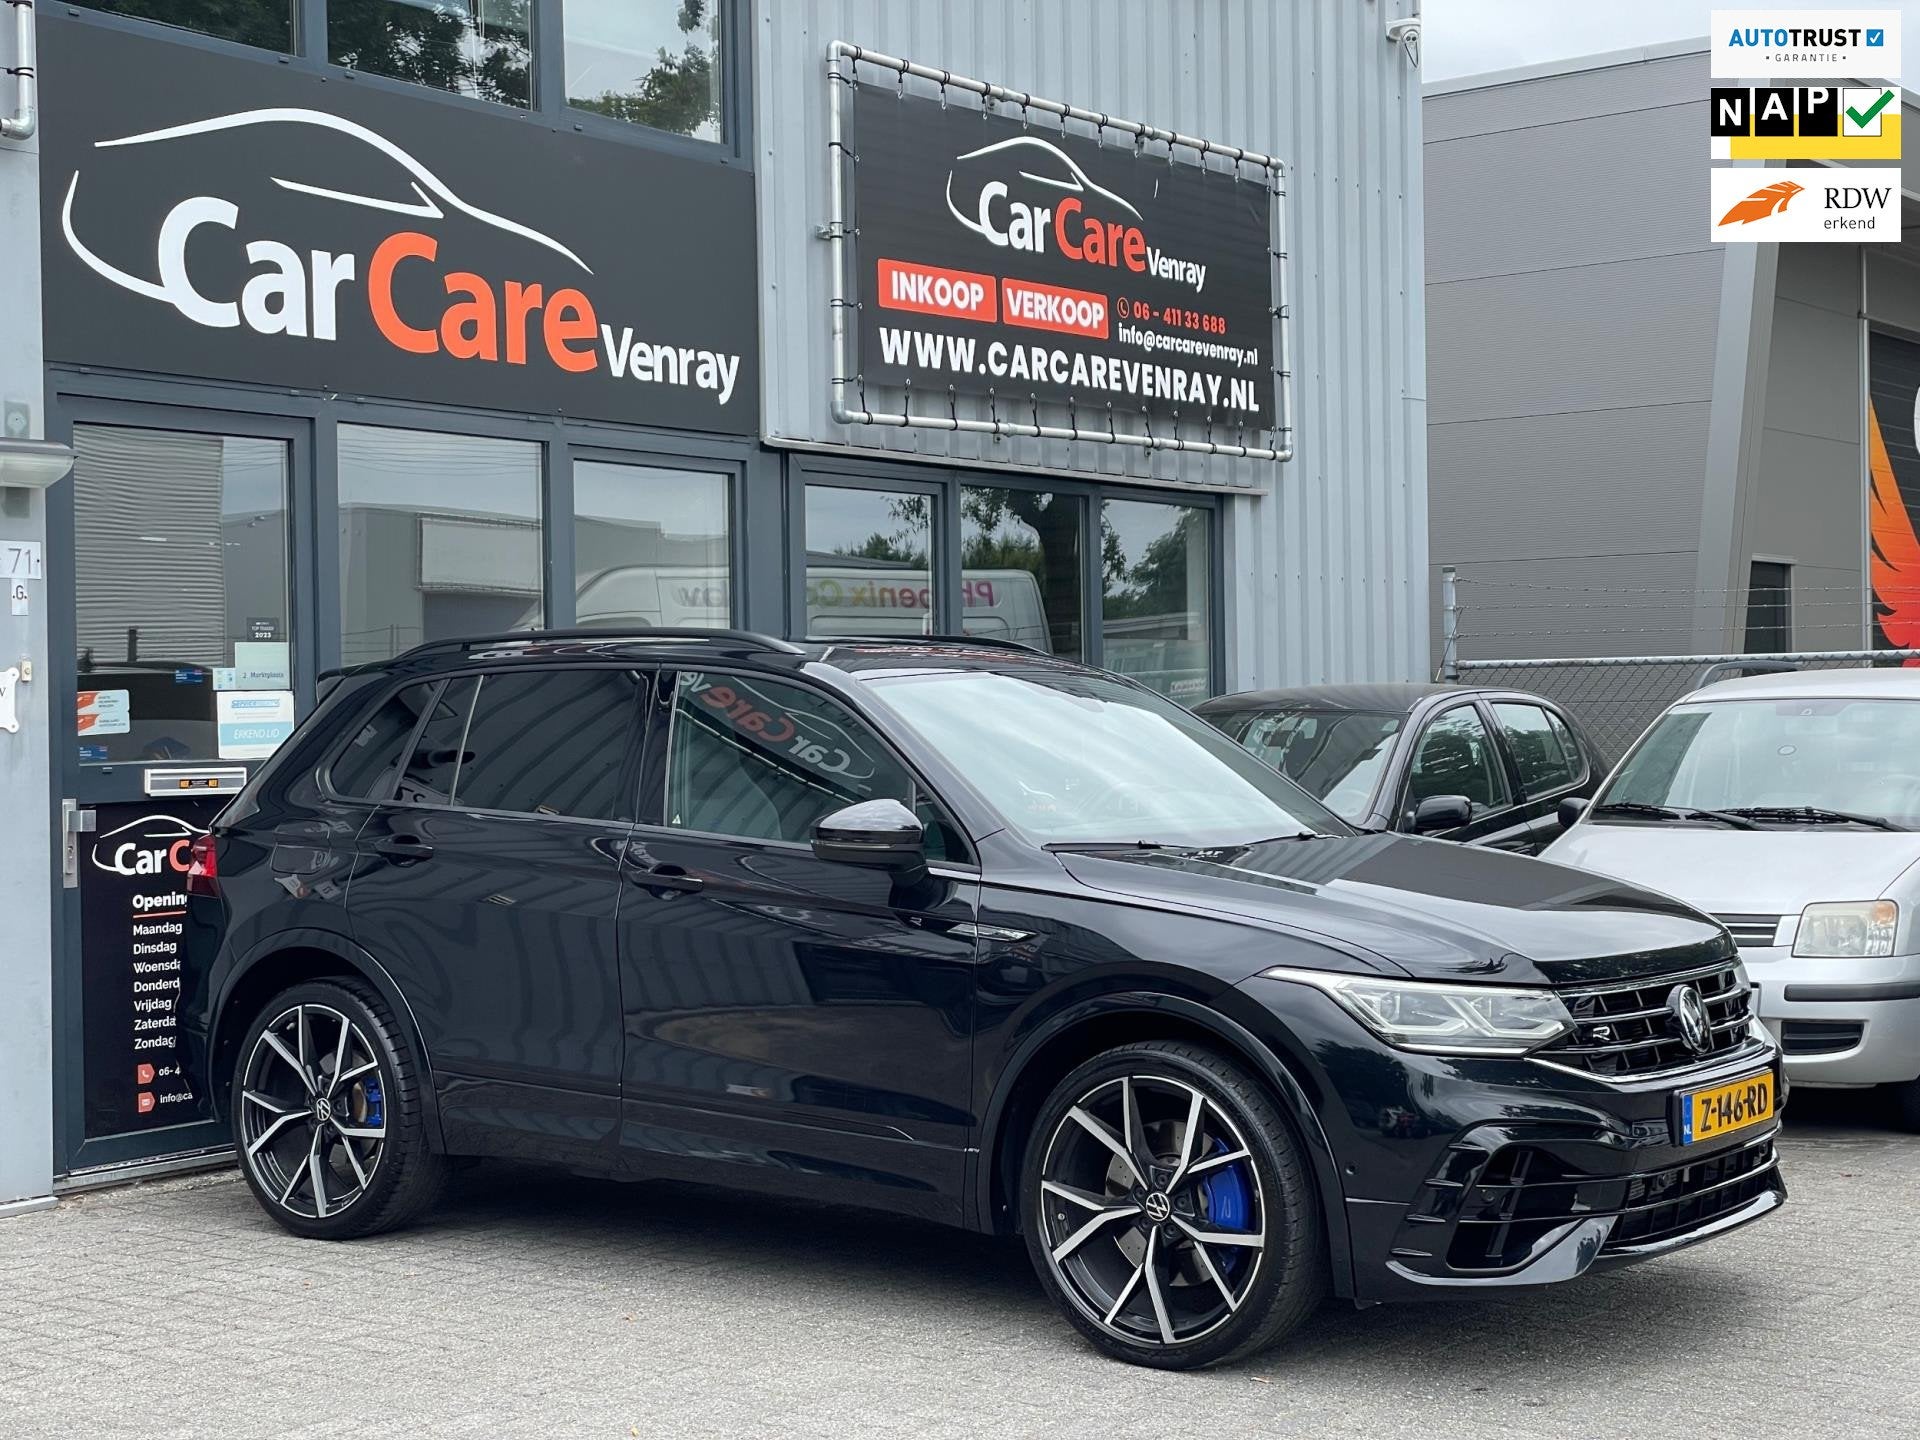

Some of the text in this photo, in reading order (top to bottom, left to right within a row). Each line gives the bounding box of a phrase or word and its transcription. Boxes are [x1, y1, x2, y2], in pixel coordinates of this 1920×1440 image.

[1146, 246, 1207, 293] Venray
[891, 270, 985, 311] INKOOP
[1006, 287, 1105, 330] VERKOOP
[1133, 301, 1150, 321] 06
[1163, 307, 1182, 327] 411
[1184, 311, 1200, 330] 33
[1202, 314, 1226, 335] 688
[1118, 322, 1259, 368] info@carcarevenray.nl
[600, 323, 741, 406] Venray
[878, 326, 1260, 413] WWW.CARCAREVENRAY.NL
[133, 922, 183, 936] Maandag
[133, 941, 177, 955] Dinsdag
[133, 959, 181, 974] Woensda
[133, 977, 181, 993] Donderd
[133, 998, 172, 1012] Vrijdag
[134, 1016, 177, 1031] Zaterda
[160, 1092, 194, 1104] info@ca
[1700, 1082, 1768, 1134] Z-146-RD
